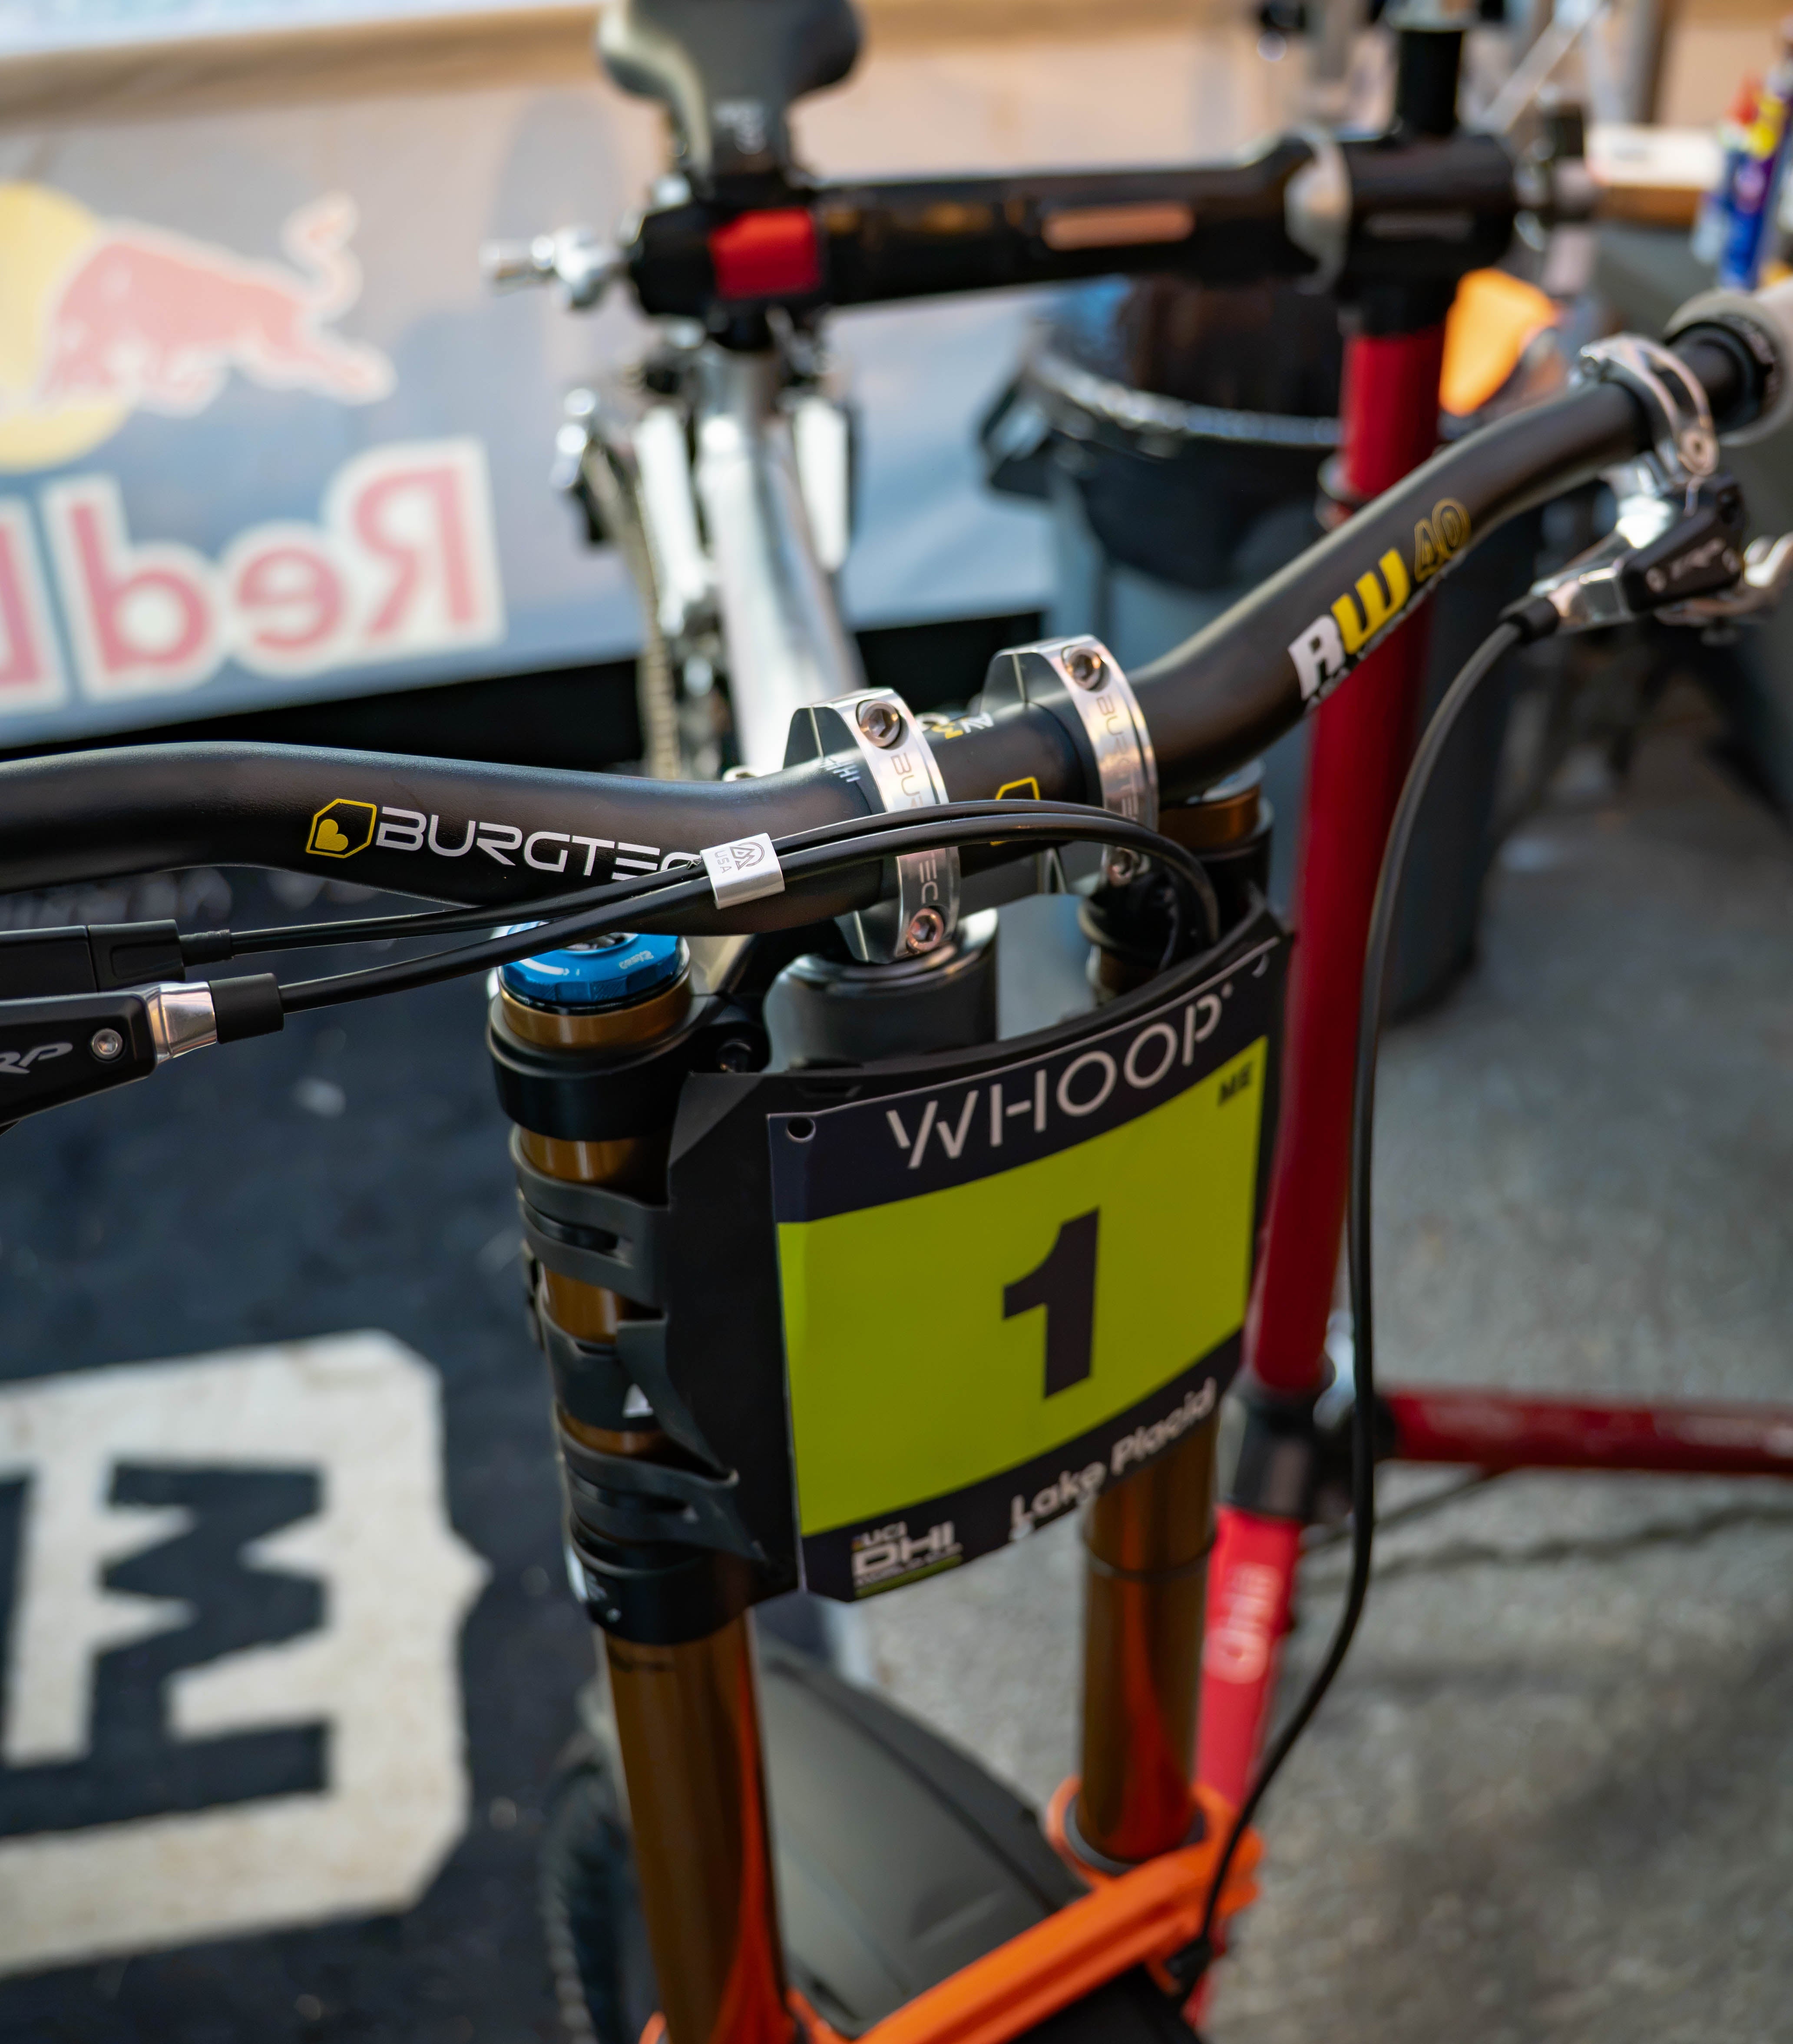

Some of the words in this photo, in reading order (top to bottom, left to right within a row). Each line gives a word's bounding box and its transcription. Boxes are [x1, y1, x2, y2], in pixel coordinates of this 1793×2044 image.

[715, 850, 732, 874] USA
[887, 994, 1221, 1168] WHOOP
[1003, 1206, 1099, 1399] 1
[1010, 1462, 1106, 1532] Lake
[1111, 1377, 1216, 1475] Placid
[853, 1521, 954, 1576] DHI
